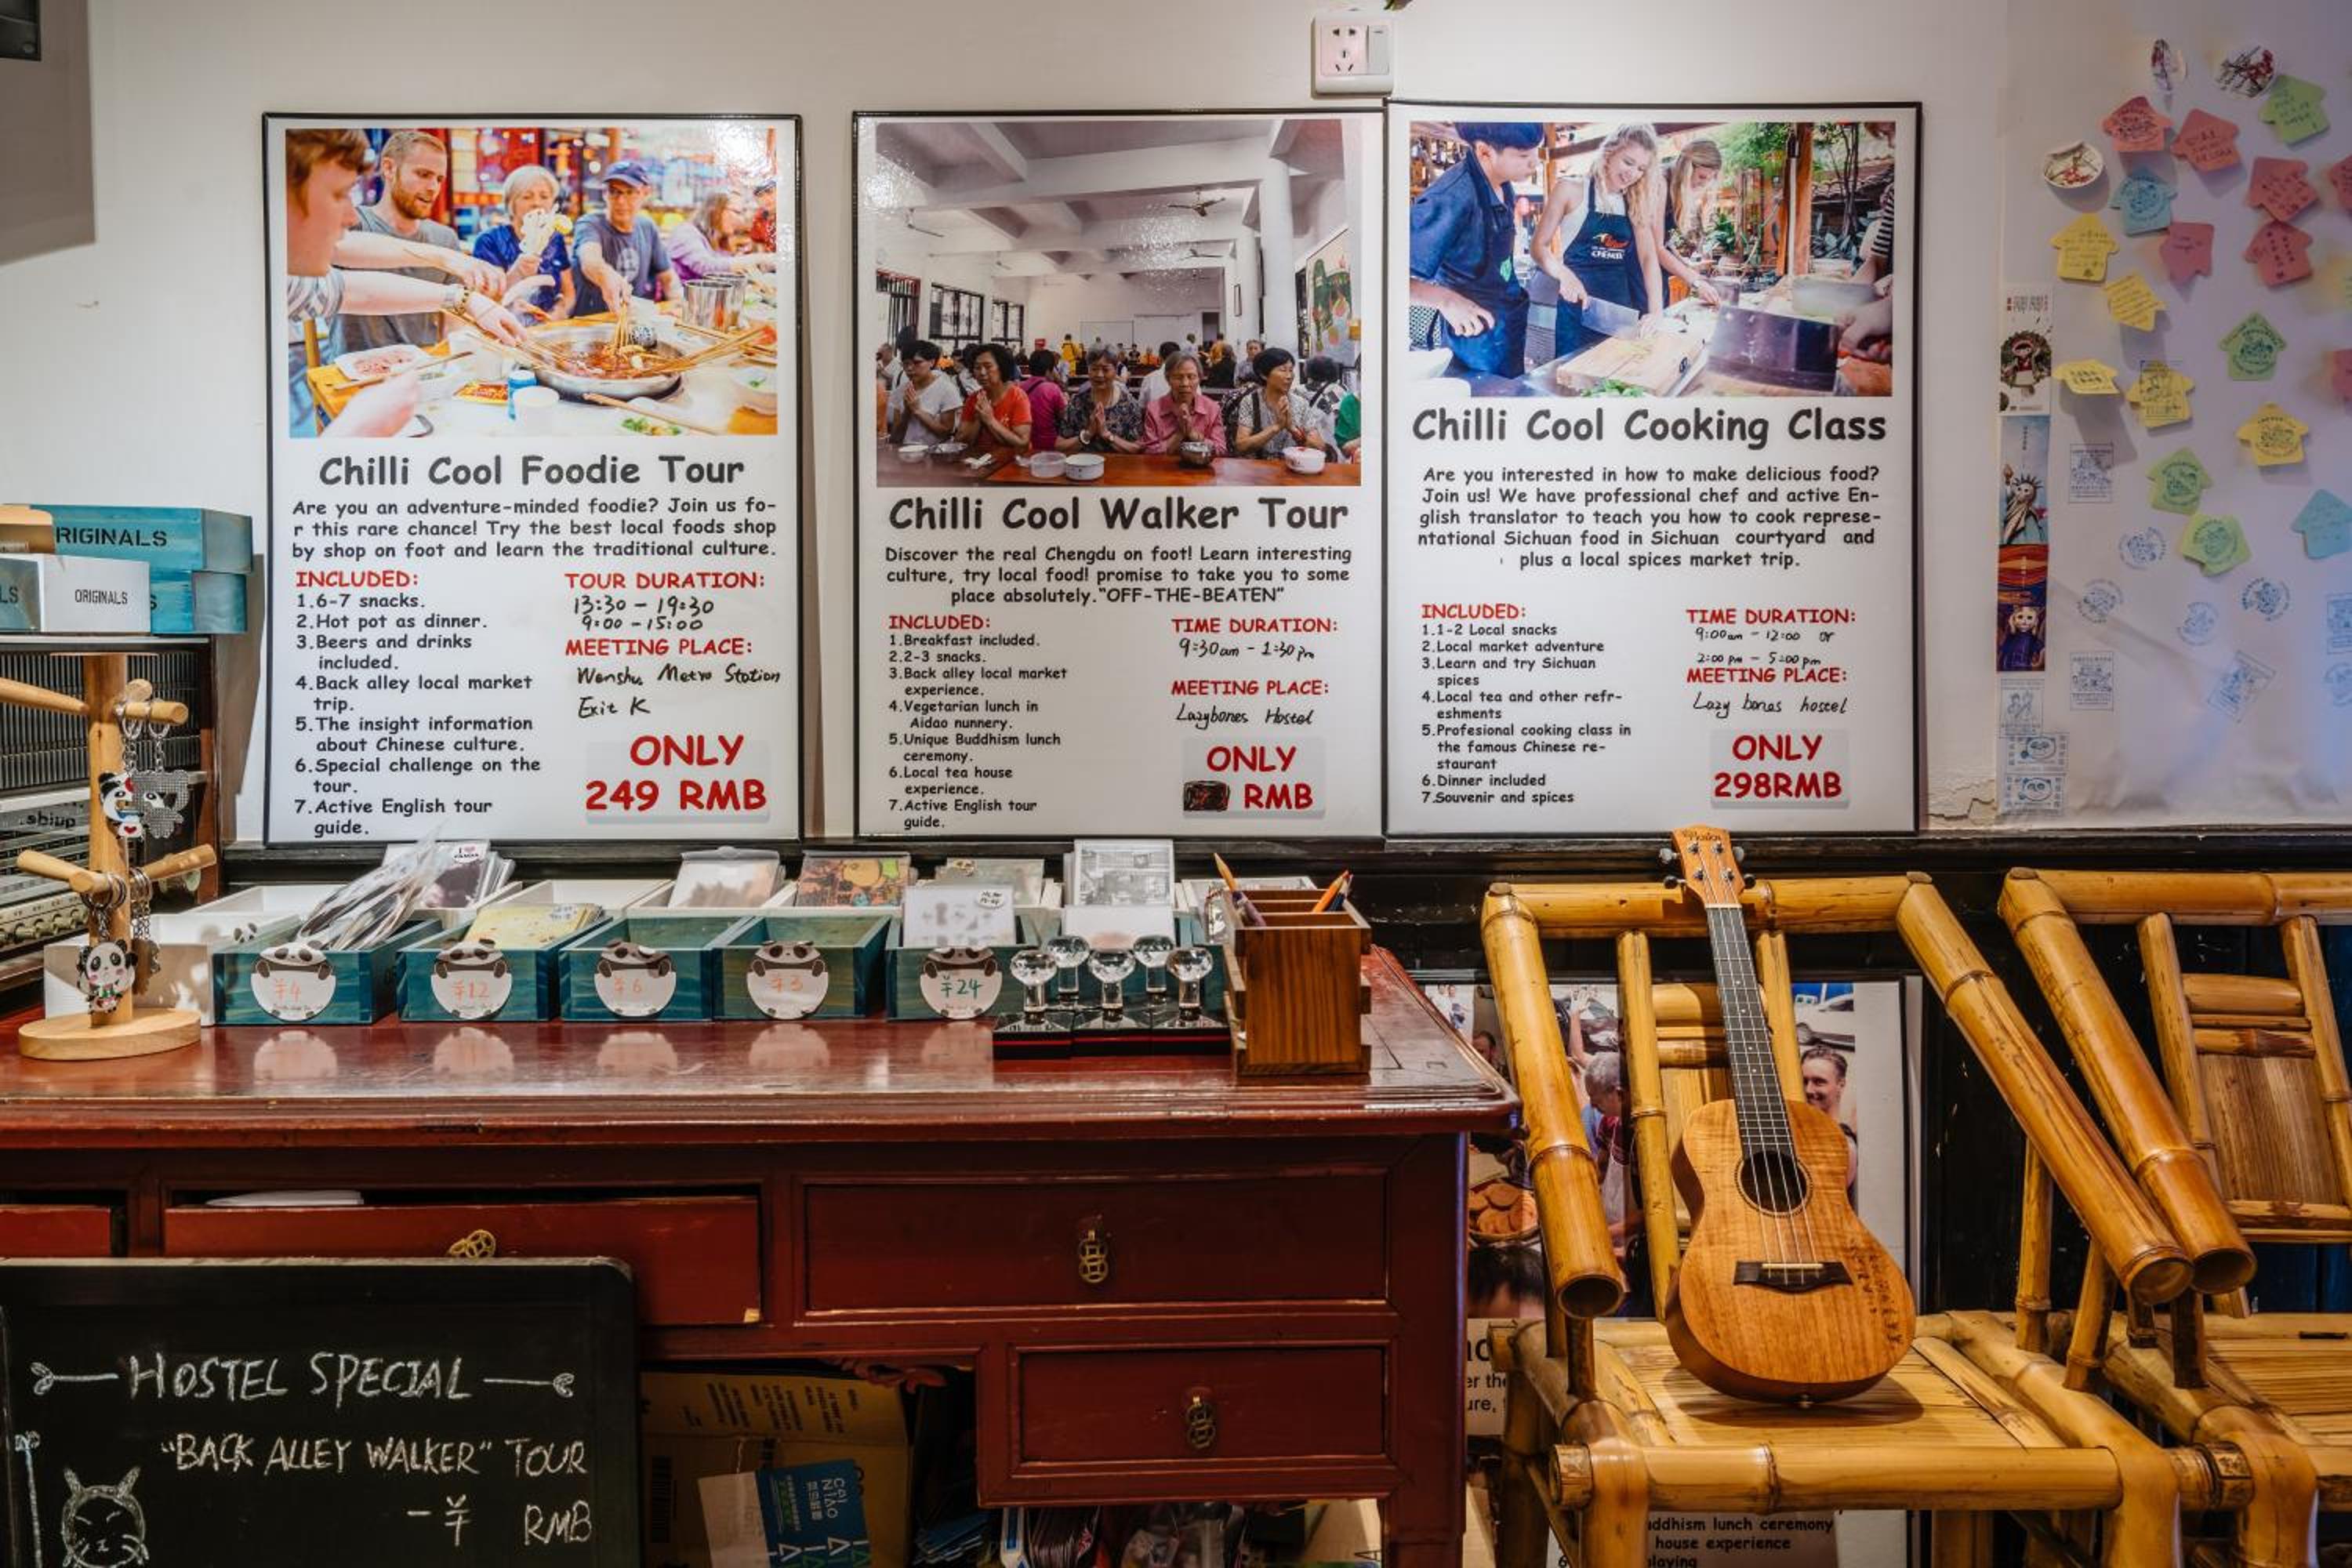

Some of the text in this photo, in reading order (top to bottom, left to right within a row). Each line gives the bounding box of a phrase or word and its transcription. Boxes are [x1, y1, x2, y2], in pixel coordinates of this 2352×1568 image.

[1413, 407, 1886, 450] Chilli Cool Cooking Class
[319, 455, 745, 486] Chilli Cool Foodie Tour
[889, 495, 1348, 530] Chilli Cool Walker Tour
[56, 526, 167, 547] RIGINALS
[312, 521, 348, 536] this
[358, 525, 398, 536] rare
[408, 520, 477, 536] chance!
[485, 521, 521, 539] Try
[529, 519, 561, 535] the
[571, 519, 612, 535] best
[621, 518, 663, 535] local
[673, 518, 725, 535] foods
[734, 517, 776, 538] shop
[1520, 550, 1800, 571] plus a local spices market trip.
[296, 570, 418, 590] INCLUDED:
[564, 572, 764, 590] TOUR DURATION:
[887, 566, 1349, 586] culture, try local food! promise to take you to some
[74, 589, 128, 605] ORIGINALS
[574, 595, 714, 617] 13:30 19:30
[1421, 604, 1526, 619] INCLUDED:
[582, 615, 703, 630] 9:00 15:00
[888, 615, 989, 630] INCLUDED:
[1686, 608, 1855, 624] TIME DURATION:
[1171, 618, 1338, 633] TIME DURATION:
[1469, 623, 1504, 636] Local
[1512, 622, 1557, 636] snacks
[565, 637, 751, 656] MEETING PLACE:
[979, 633, 1040, 646] included.
[1479, 640, 1529, 652] market
[1535, 639, 1604, 652] adventure
[319, 654, 398, 670] included.
[1483, 656, 1507, 669] and
[1513, 659, 1535, 672] try
[1541, 656, 1596, 669] Sichuan
[1697, 652, 1724, 663] 2:00
[1769, 652, 1799, 665] 5:00
[724, 662, 780, 684] Station
[942, 666, 975, 682] alley
[981, 666, 1011, 679] local
[1018, 667, 1067, 680] market
[1437, 674, 1479, 689] spices
[1686, 667, 1846, 684] MEETING PLACE:
[905, 683, 984, 699] experience.
[1171, 680, 1328, 695] MEETING PLACE:
[1479, 691, 1502, 702] tea
[1509, 690, 1533, 702] and
[1539, 690, 1577, 702] other
[314, 696, 354, 715] trip.
[578, 696, 651, 719] Exit K
[1437, 707, 1502, 720] eshments
[1693, 691, 1730, 719] Lazy
[909, 717, 1012, 731] Aidao nunnery.
[1175, 702, 1314, 731] Lazybones Hostel
[316, 735, 524, 752] about Chinese culture.
[956, 732, 1019, 746] Buddhism
[1026, 732, 1061, 745] lunch
[1438, 740, 1461, 753] the
[1467, 740, 1517, 753] famous
[1523, 740, 1576, 753] Chinese
[630, 735, 744, 766] ONLY
[1732, 735, 1822, 761] ONLY
[903, 753, 973, 764] ceremony.
[1207, 746, 1297, 772] ONLY
[1436, 758, 1497, 770] staurant
[1715, 771, 1842, 799] 298RMB
[586, 779, 767, 811] 249 RMB
[1244, 782, 1312, 809] RMB
[314, 818, 368, 838] guide.
[904, 815, 944, 830] guide.
[310, 1351, 470, 1408] SPECIAL
[264, 1436, 351, 1475] ALLEY
[505, 1438, 587, 1477] TOUR
[524, 1500, 591, 1545] RMB
[1713, 1517, 1752, 1531] lunch
[1760, 1519, 1833, 1534] ceremony
[1656, 1536, 1791, 1553] house experience
